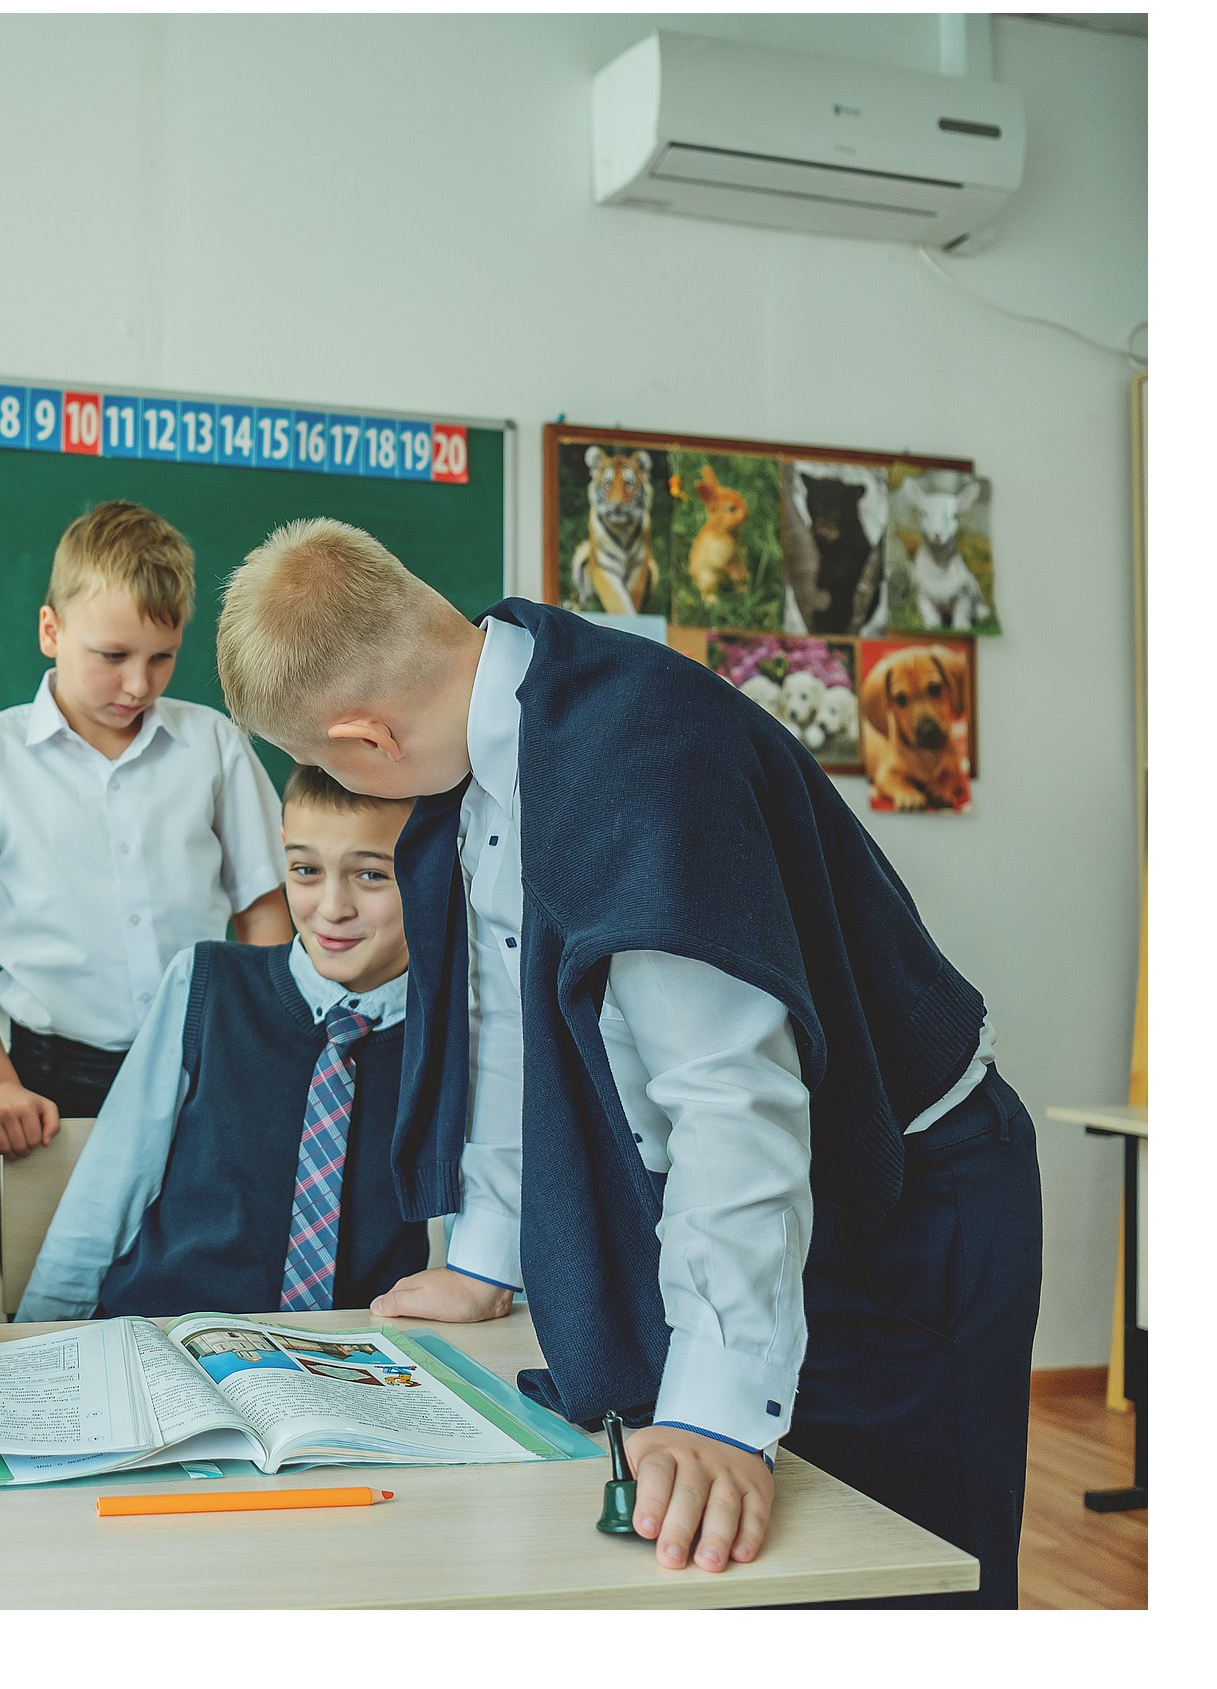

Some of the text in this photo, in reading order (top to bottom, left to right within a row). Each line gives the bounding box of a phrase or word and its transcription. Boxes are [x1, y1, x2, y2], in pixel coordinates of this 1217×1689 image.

[0, 396, 21, 438] 8
[35, 399, 55, 441] 9
[67, 401, 97, 446] 10
[106, 406, 134, 447] 11
[144, 409, 175, 451] 12
[183, 413, 212, 453] 13
[221, 416, 252, 456] 14
[259, 418, 289, 459] 15
[296, 421, 324, 462] 16
[330, 425, 358, 465] 17
[365, 428, 395, 468] 18
[400, 431, 430, 470] 19
[433, 433, 465, 475] 20
